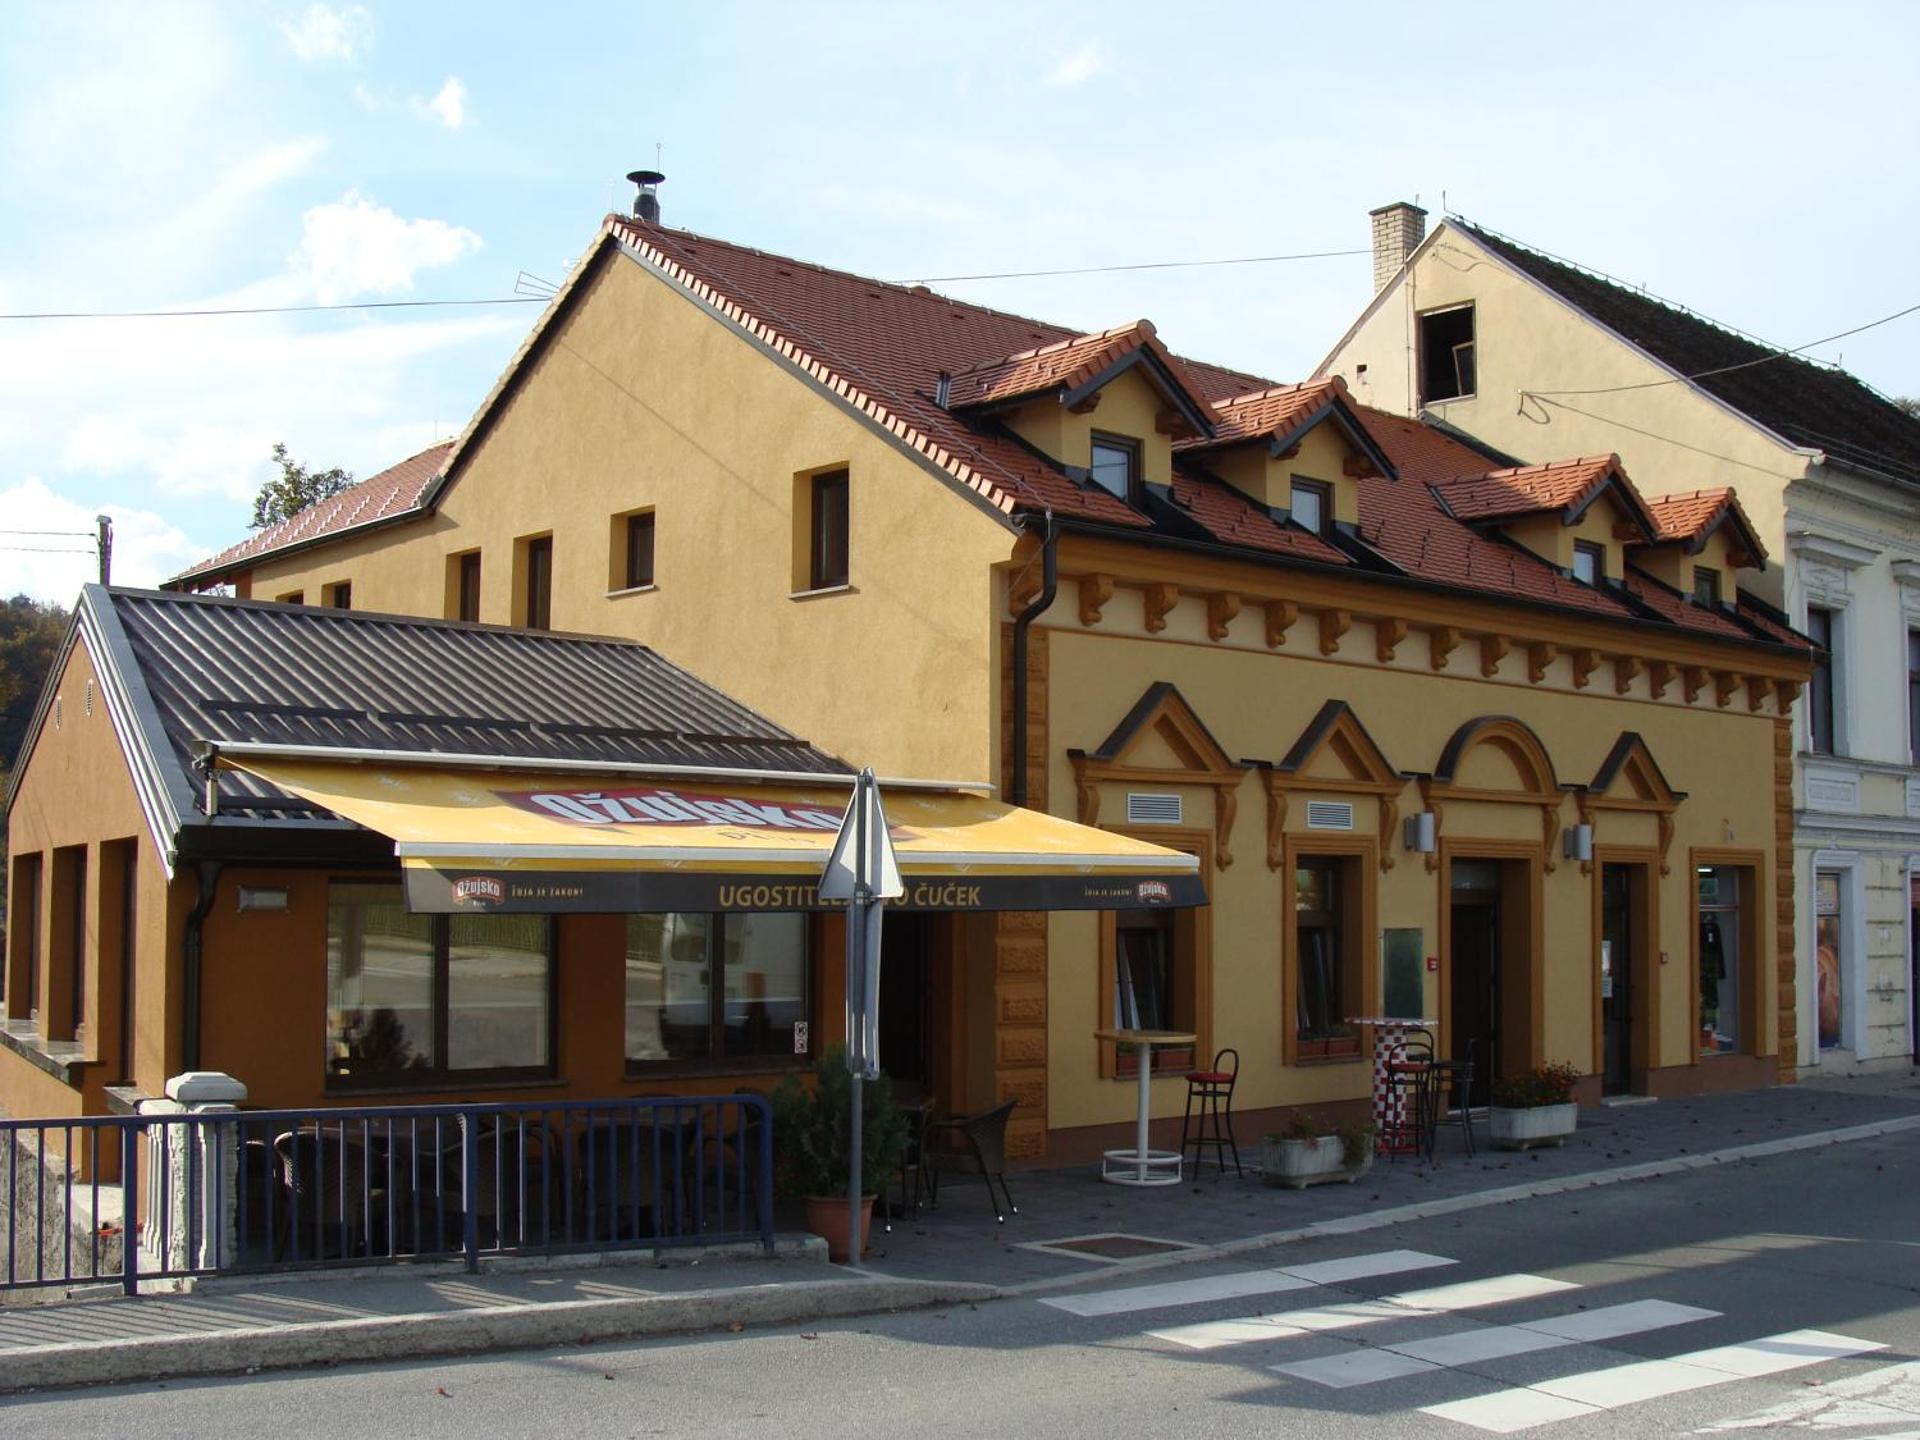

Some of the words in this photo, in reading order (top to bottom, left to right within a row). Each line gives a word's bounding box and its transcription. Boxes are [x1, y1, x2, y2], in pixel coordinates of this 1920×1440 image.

[457, 878, 500, 897] Ožujsko
[719, 885, 909, 907] UGOSTITO
[914, 882, 981, 906] ČUČEK
